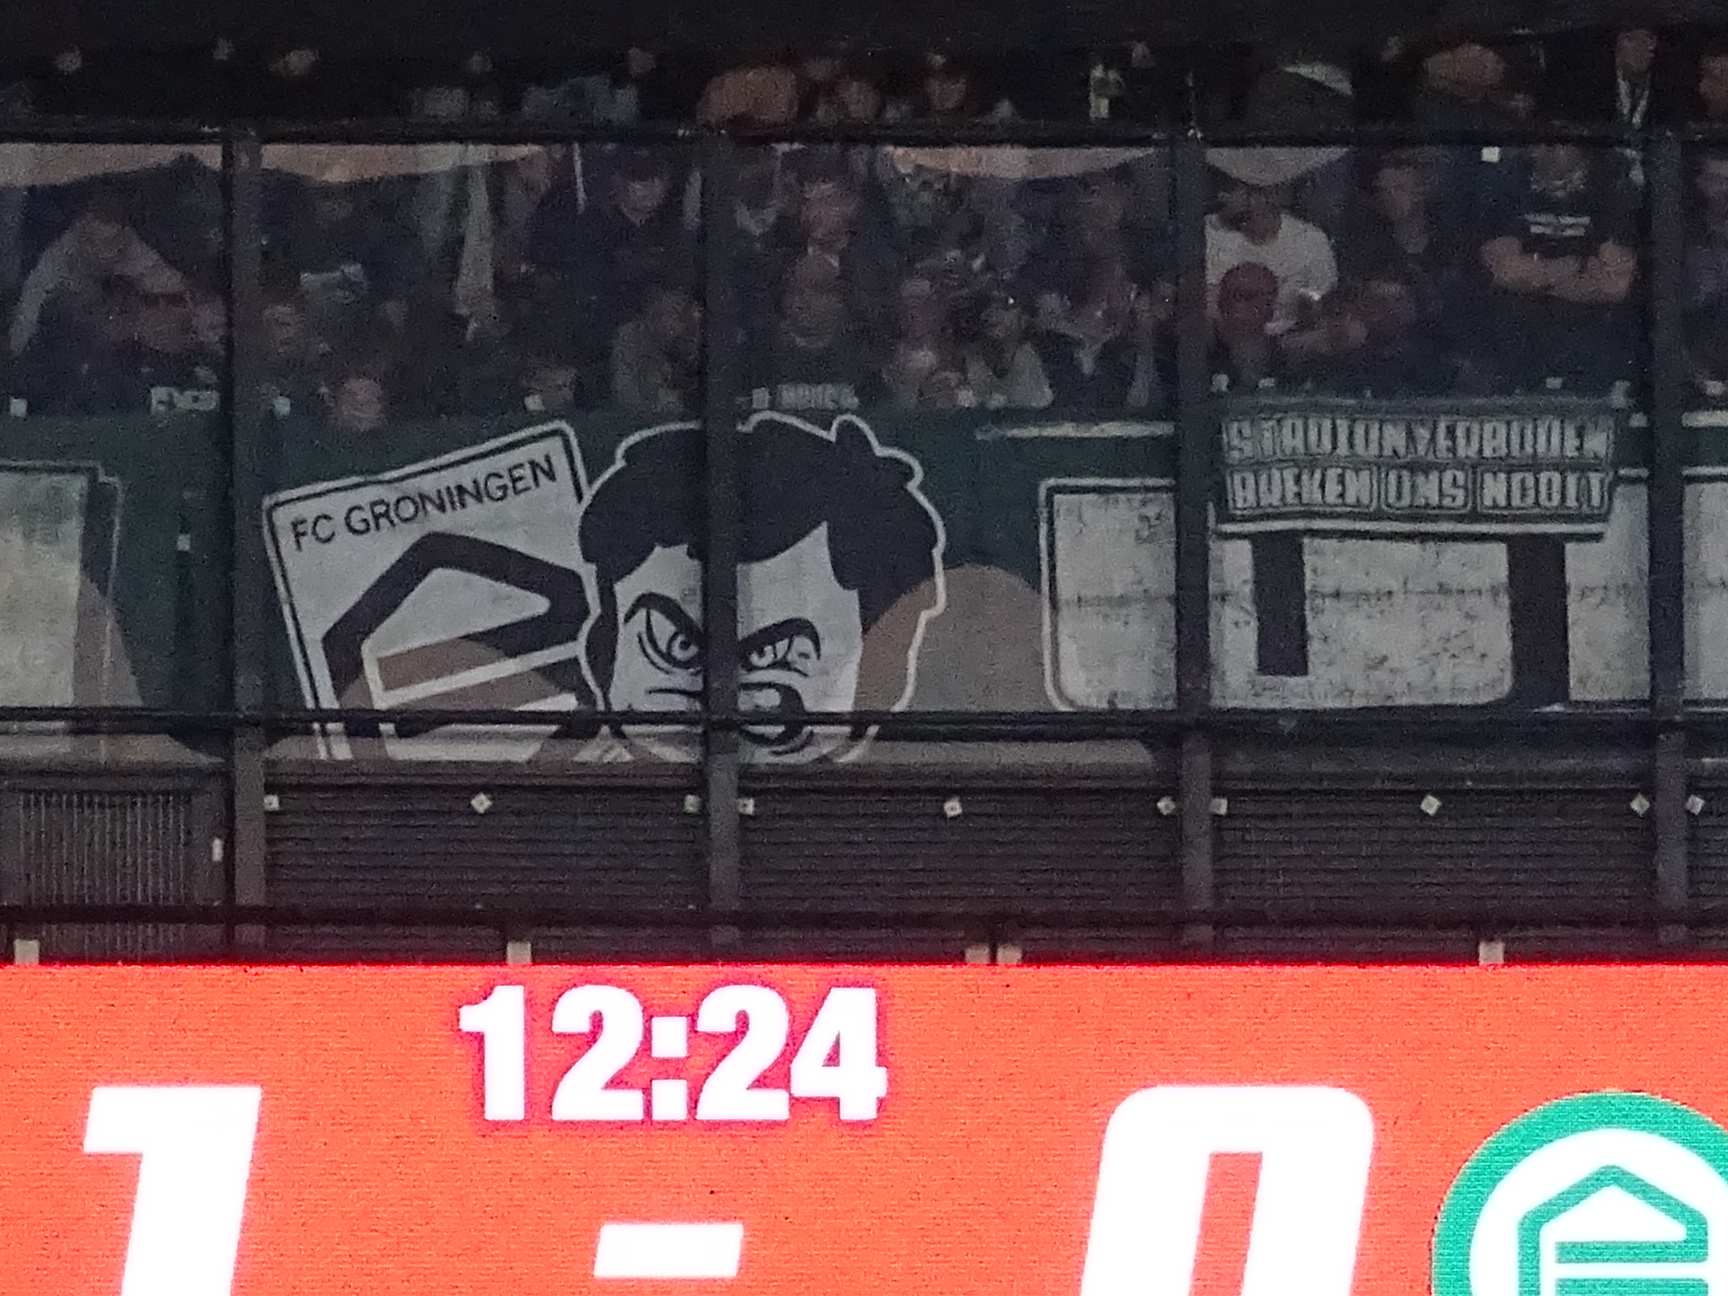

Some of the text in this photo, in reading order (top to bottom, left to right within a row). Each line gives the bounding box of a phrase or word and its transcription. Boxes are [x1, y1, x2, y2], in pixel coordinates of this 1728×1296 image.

[289, 456, 558, 553] FC GRONINGEN
[460, 986, 889, 1121] 12:24
